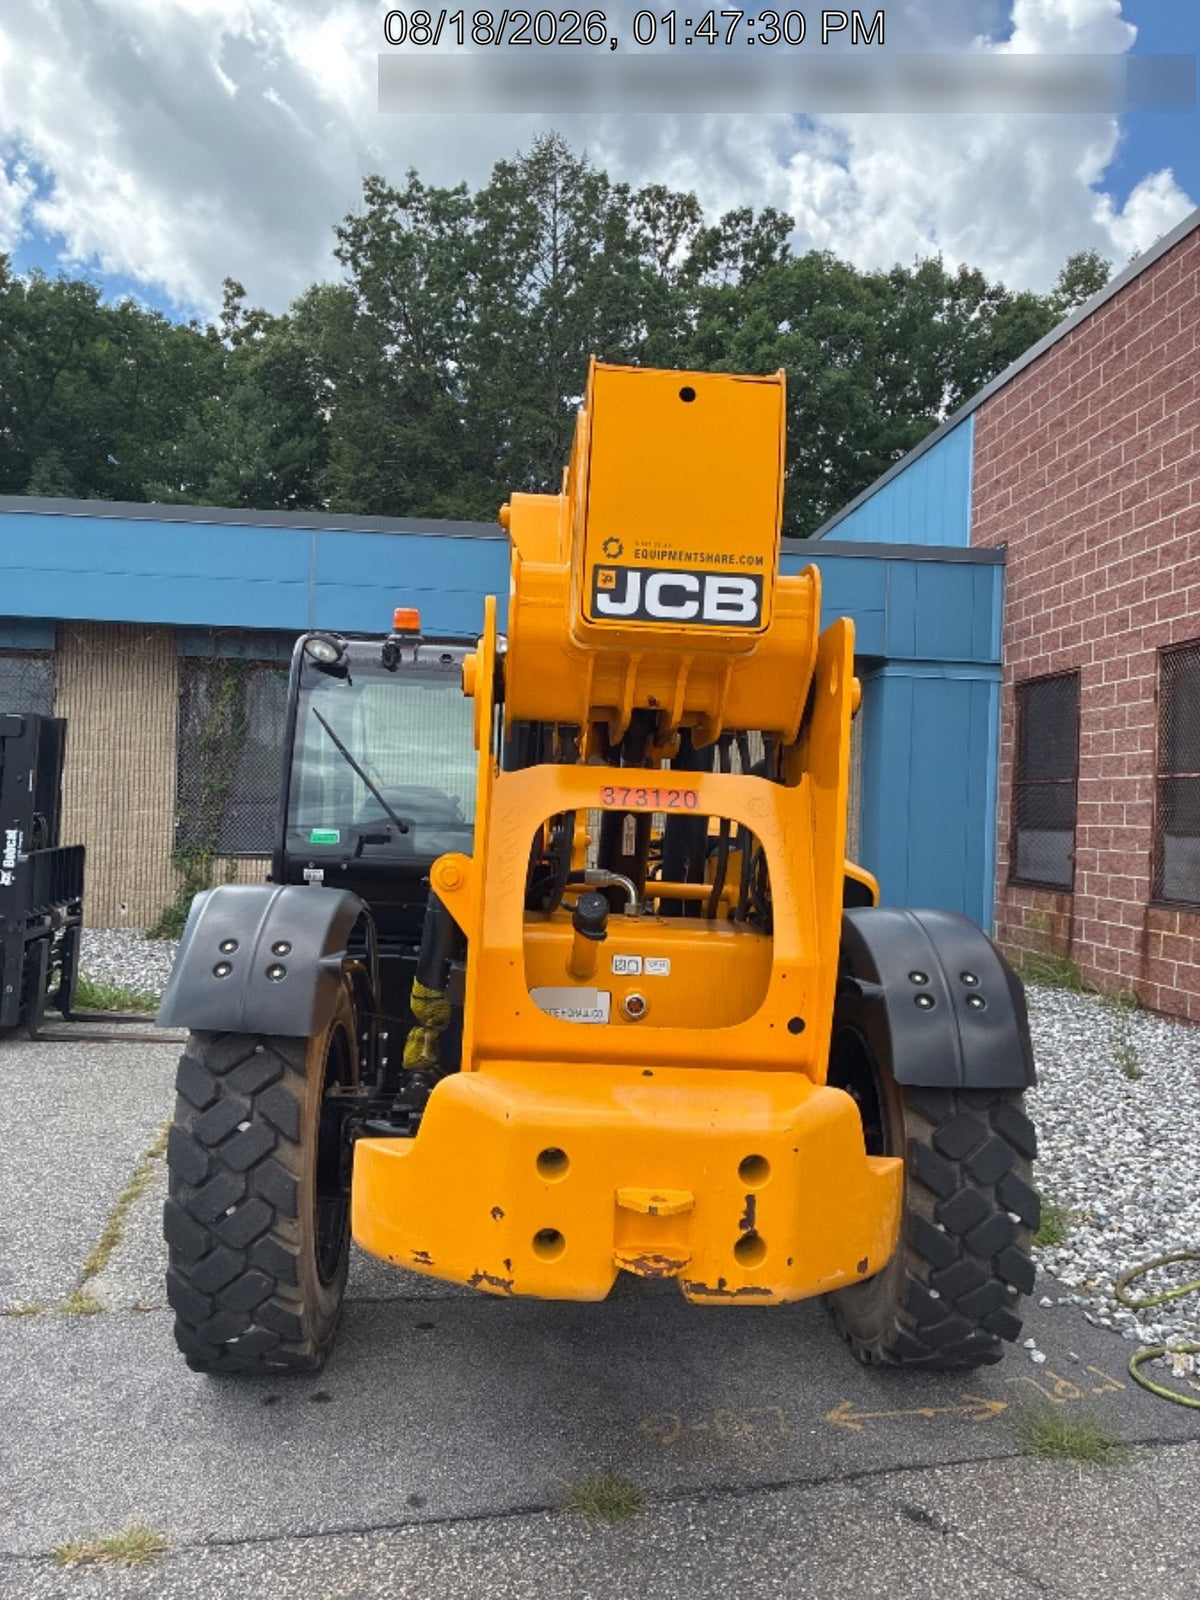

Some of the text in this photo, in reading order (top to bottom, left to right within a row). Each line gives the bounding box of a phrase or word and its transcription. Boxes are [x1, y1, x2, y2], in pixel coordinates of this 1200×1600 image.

[634, 549, 764, 566] EQUIPMENTSHARE.COM
[596, 570, 758, 622] JCB
[603, 786, 698, 809] 373120
